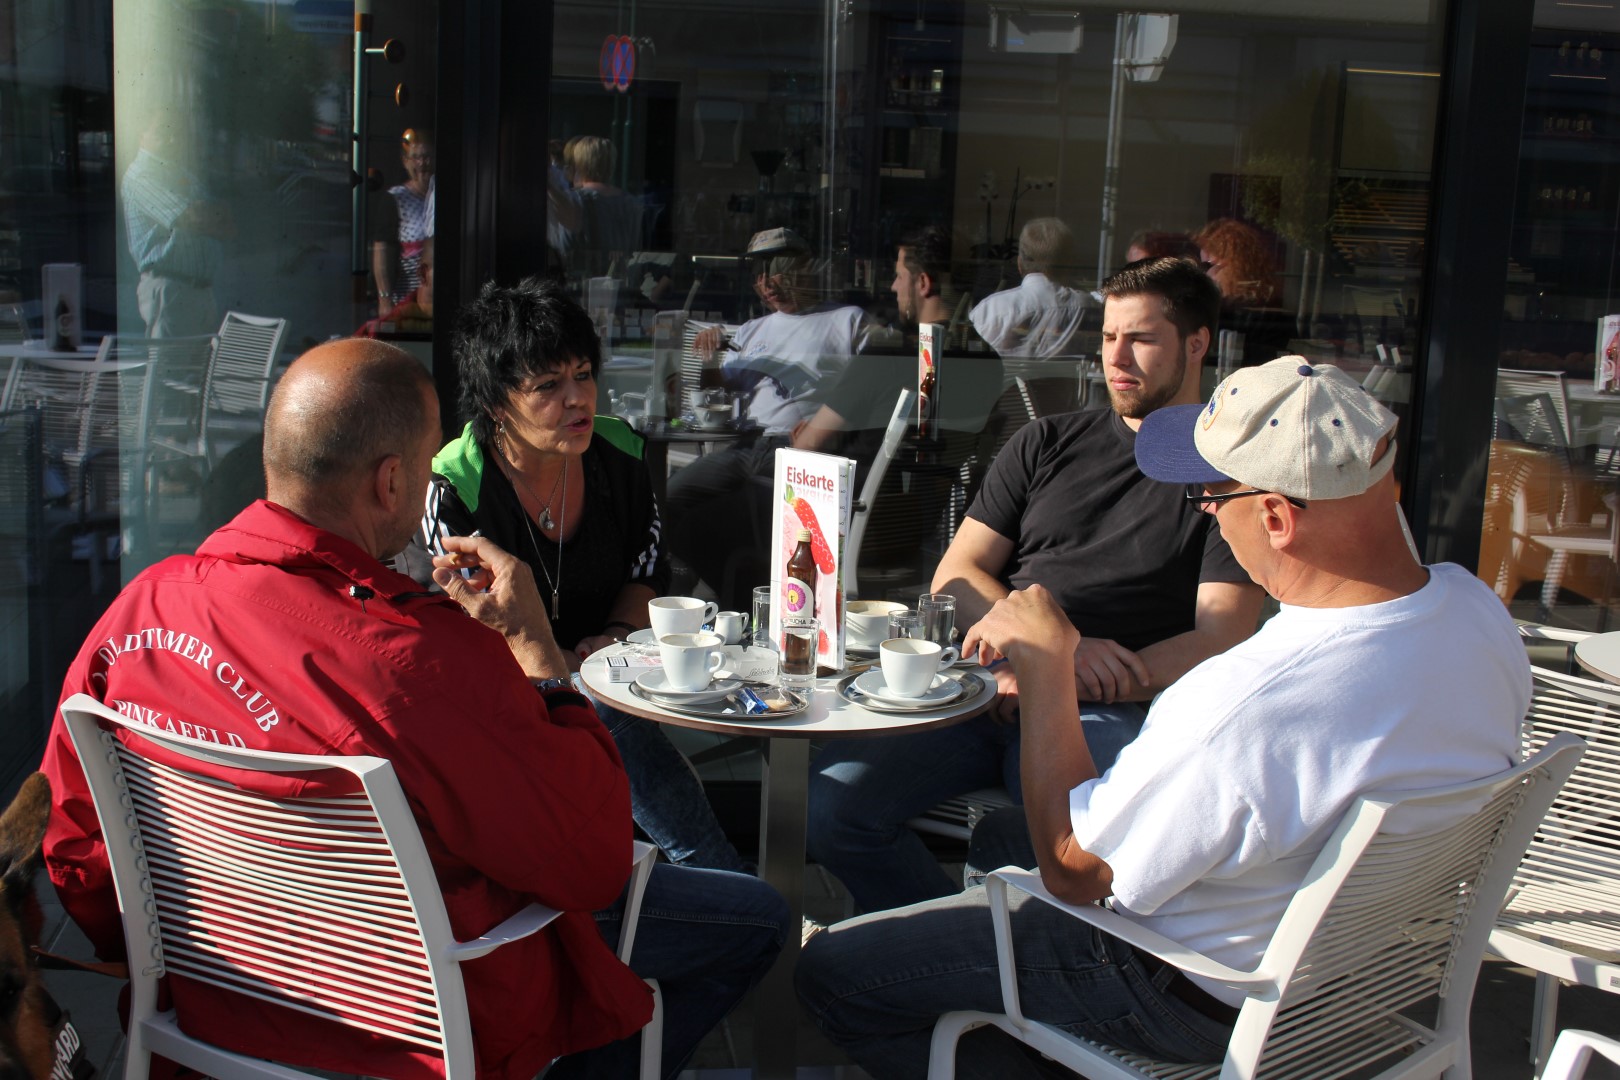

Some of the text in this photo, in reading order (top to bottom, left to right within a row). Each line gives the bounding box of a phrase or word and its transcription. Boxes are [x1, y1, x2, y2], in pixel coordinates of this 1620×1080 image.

[787, 466, 834, 492] Eiskarte
[98, 627, 213, 671] OLDTIMER
[216, 661, 279, 732] CLUB
